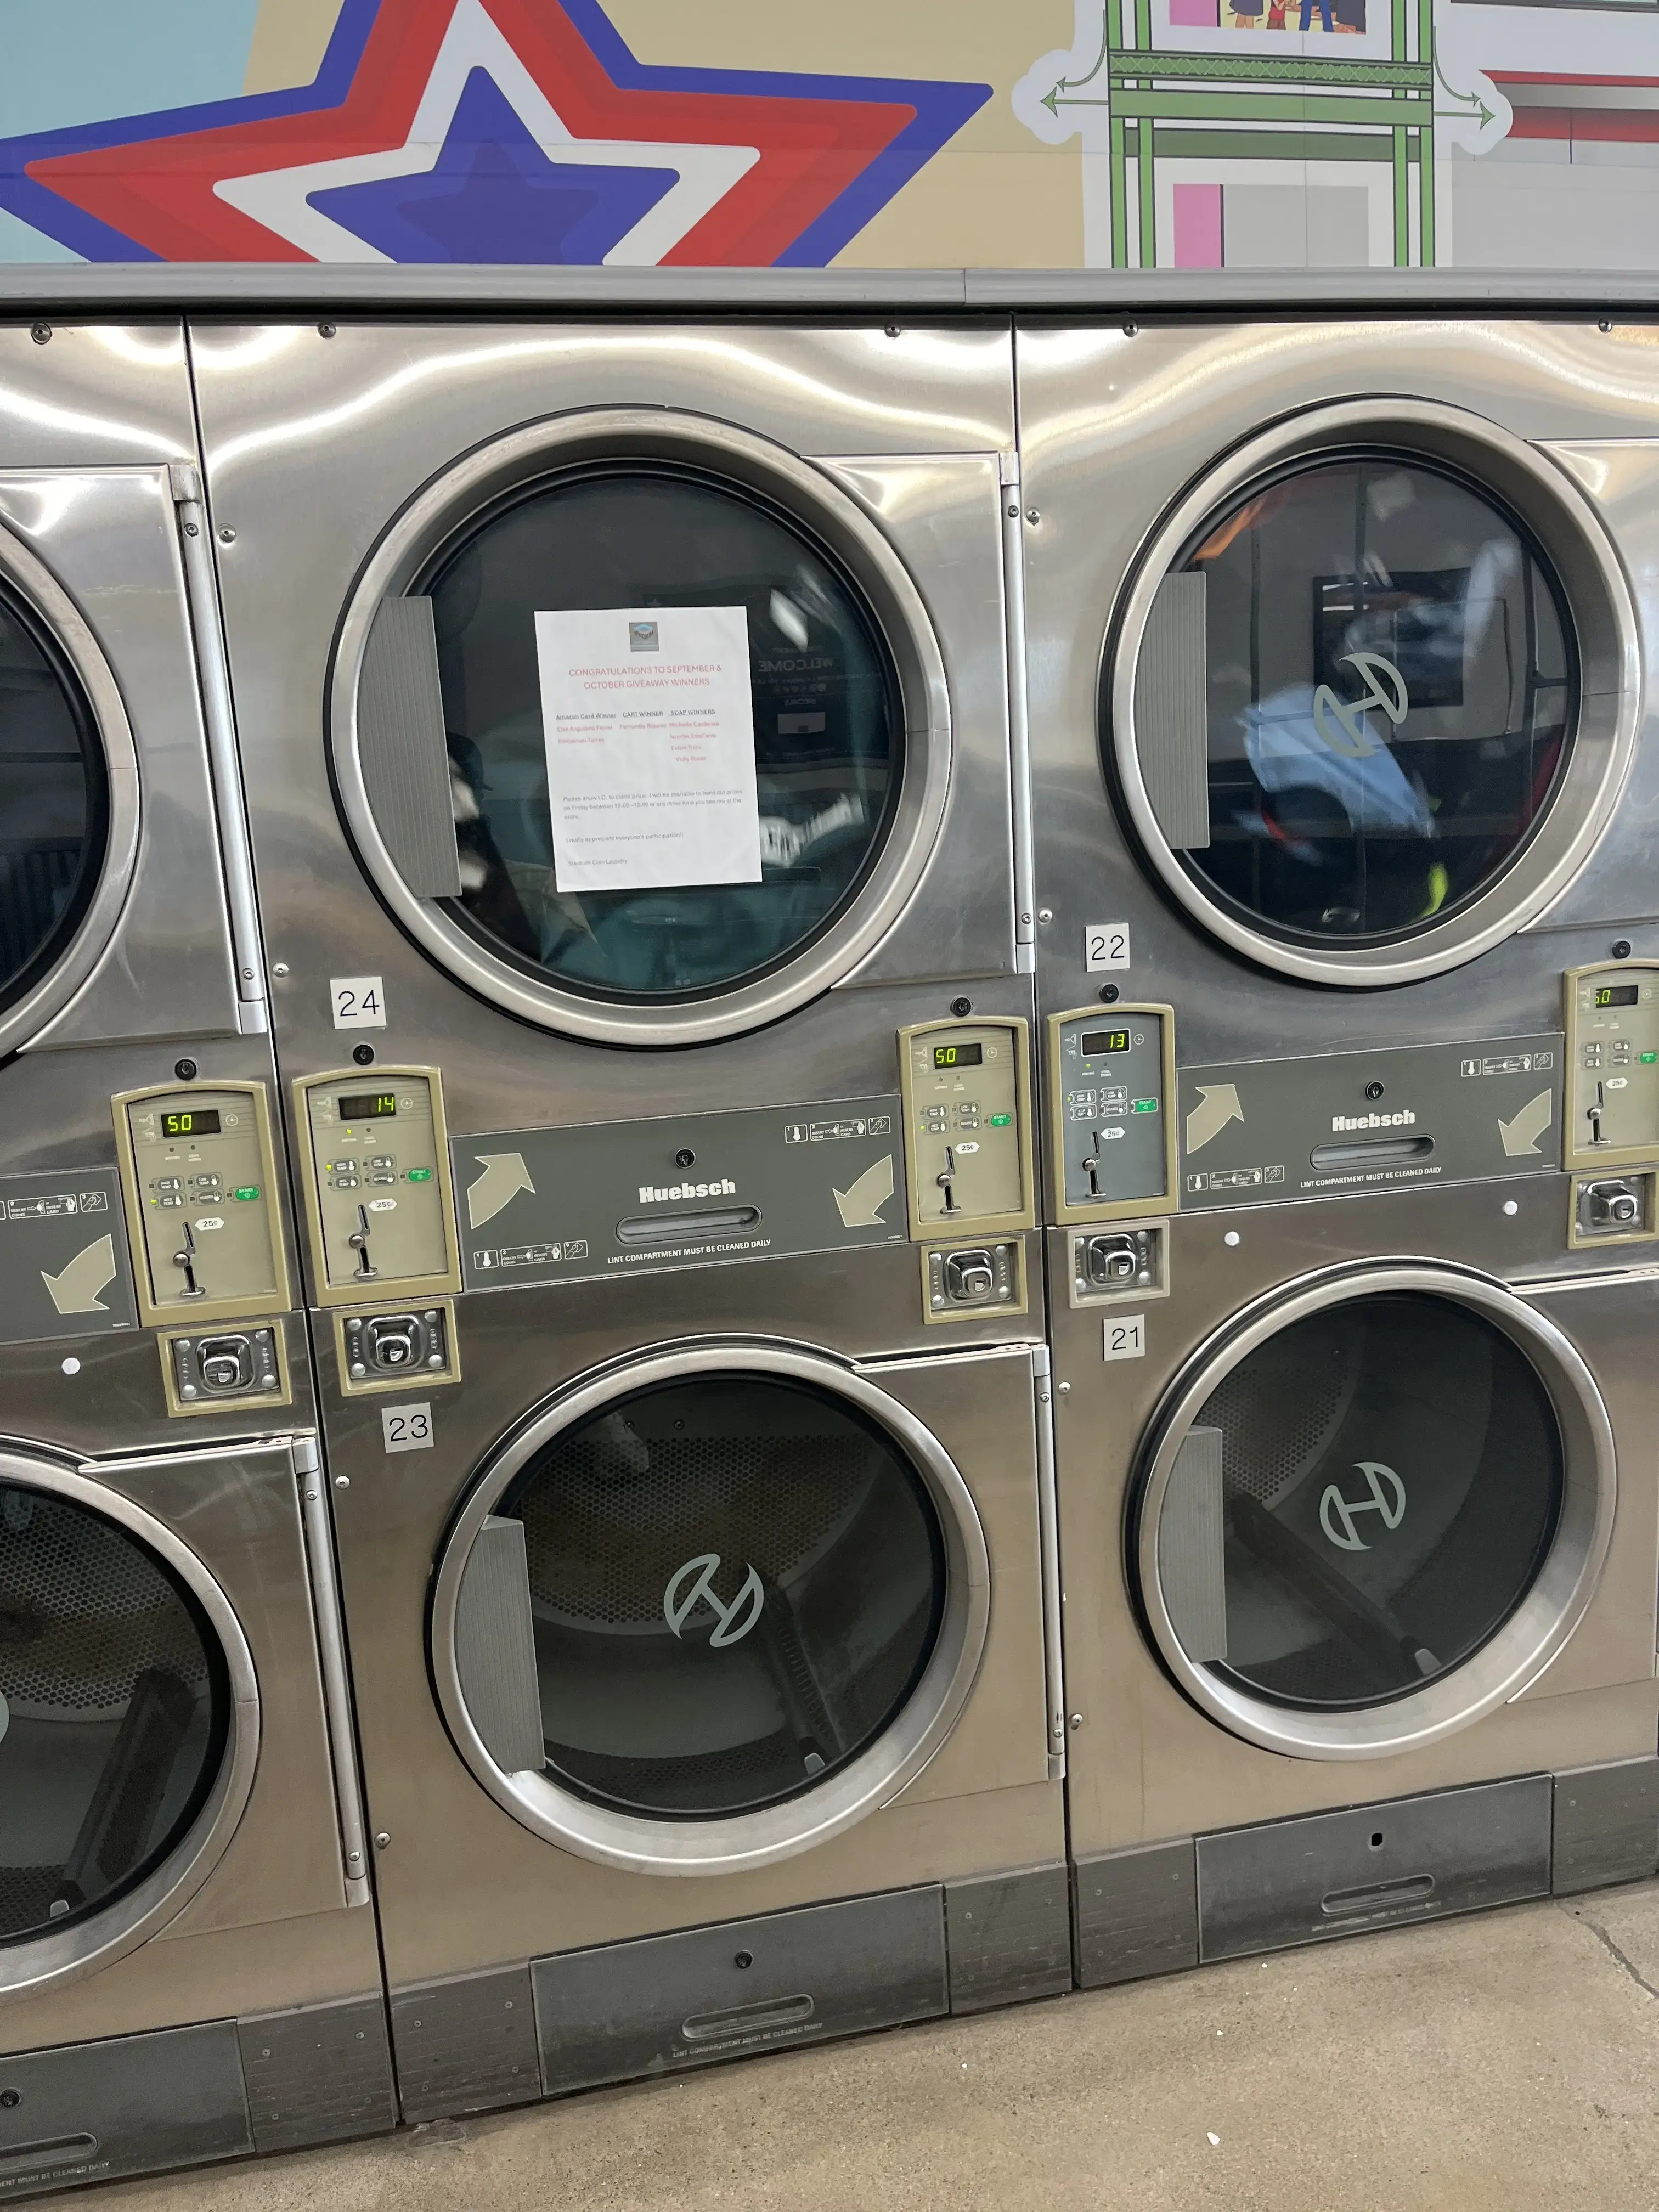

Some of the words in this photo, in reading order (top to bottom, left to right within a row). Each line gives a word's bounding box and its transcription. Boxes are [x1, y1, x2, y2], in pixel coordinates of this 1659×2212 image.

[569, 667, 652, 676] CONGRATULATIONS
[667, 665, 714, 673] SEPTEMBER
[626, 679, 669, 688] GIVEAWAY
[671, 678, 709, 686] WINNERS
[1091, 935, 1125, 961] 22
[338, 989, 380, 1017] 24
[1109, 1034, 1125, 1048] 13
[936, 1048, 956, 1064] 50
[377, 1096, 394, 1112] 14
[167, 1115, 193, 1131] 50
[1332, 1110, 1415, 1132] Huebsch
[1316, 1175, 1364, 1187] COMPARTMENT
[1395, 1169, 1423, 1178] CLEANED
[639, 1179, 736, 1203] Huebsch
[625, 1250, 682, 1262] COMPARTMENT
[684, 1246, 704, 1255] MUST
[716, 1242, 749, 1251] CLEANED
[751, 1239, 771, 1248] DAILY
[1112, 1326, 1138, 1350] 21
[389, 1415, 428, 1441] 23
[673, 2050, 687, 2058] LINT
[689, 2039, 741, 2055] COMPARTMENT
[742, 2035, 761, 2044] MUST
[804, 2023, 823, 2032] DAILY
[18, 2174, 39, 2183] MUST
[53, 2166, 87, 2177] CLEANED
